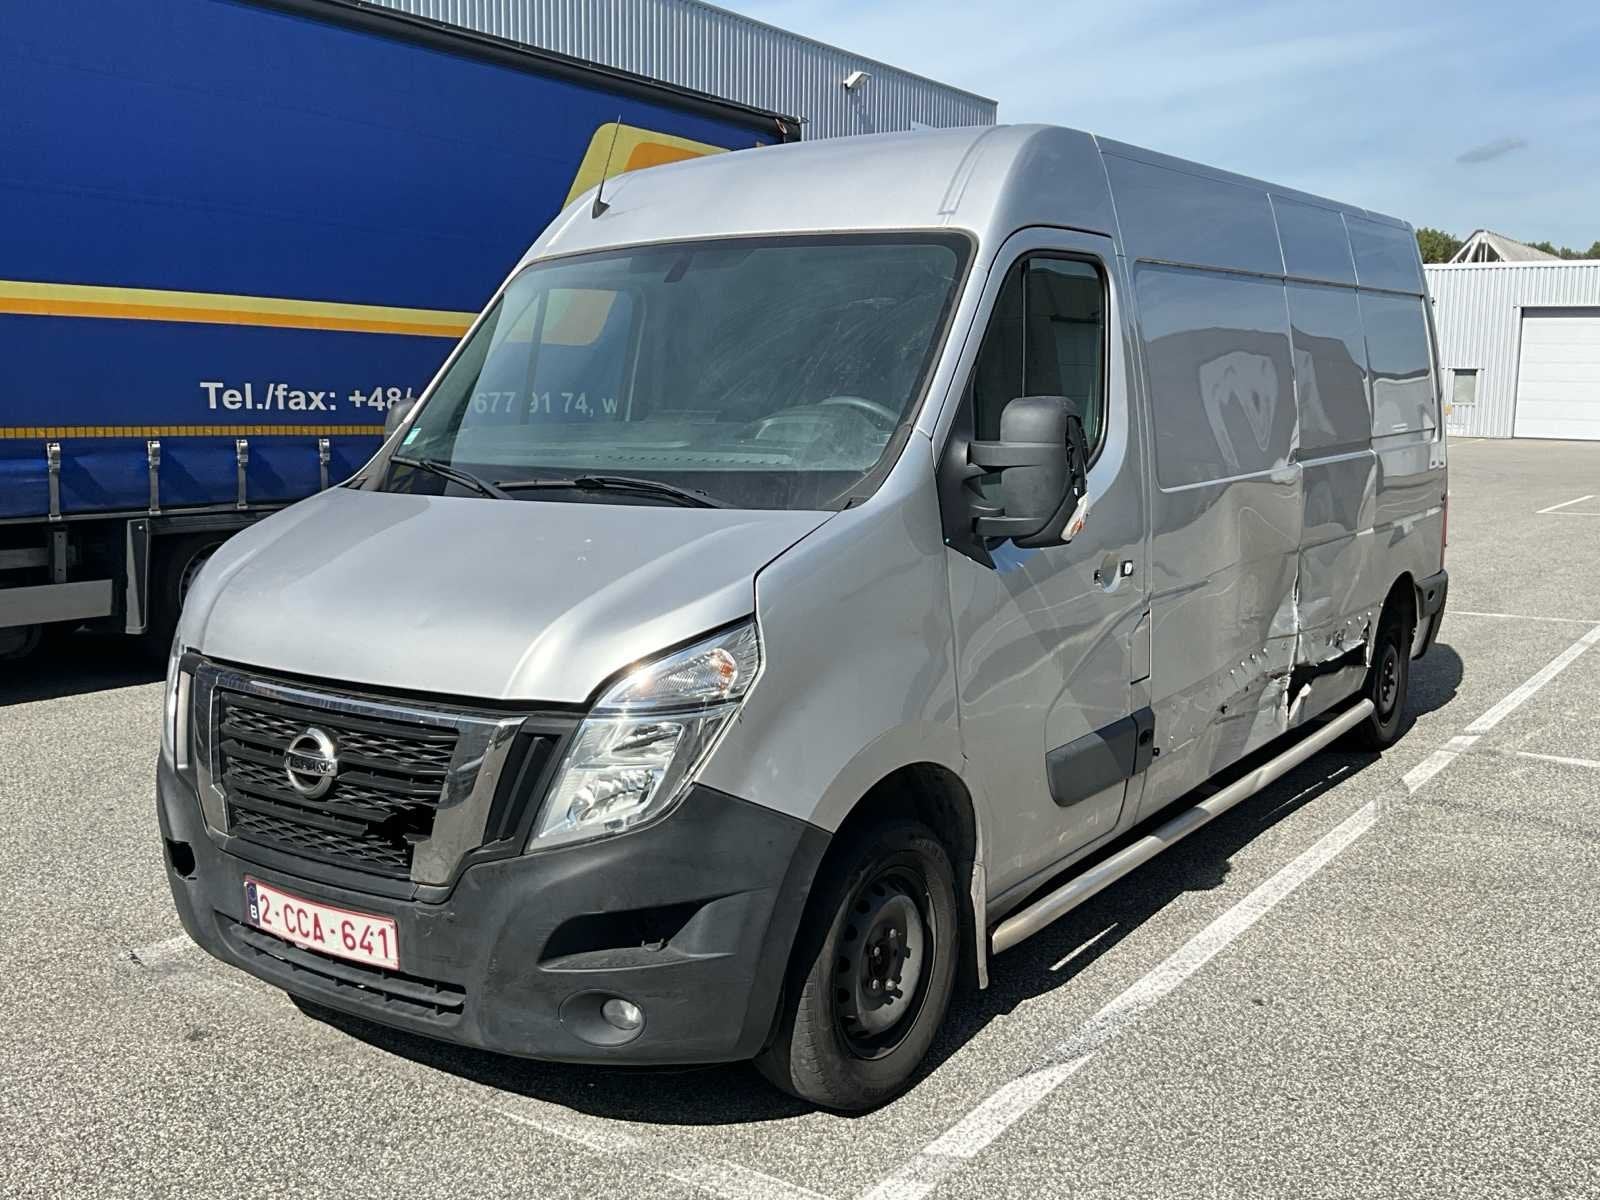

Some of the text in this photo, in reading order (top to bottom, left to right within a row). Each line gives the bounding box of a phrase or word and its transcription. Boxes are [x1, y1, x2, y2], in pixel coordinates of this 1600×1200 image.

[200, 382, 336, 411] Tel./fax:
[474, 391, 516, 414] 677
[561, 391, 594, 417] 74,
[250, 904, 258, 919] B
[260, 894, 388, 959] 2-CCA-641
